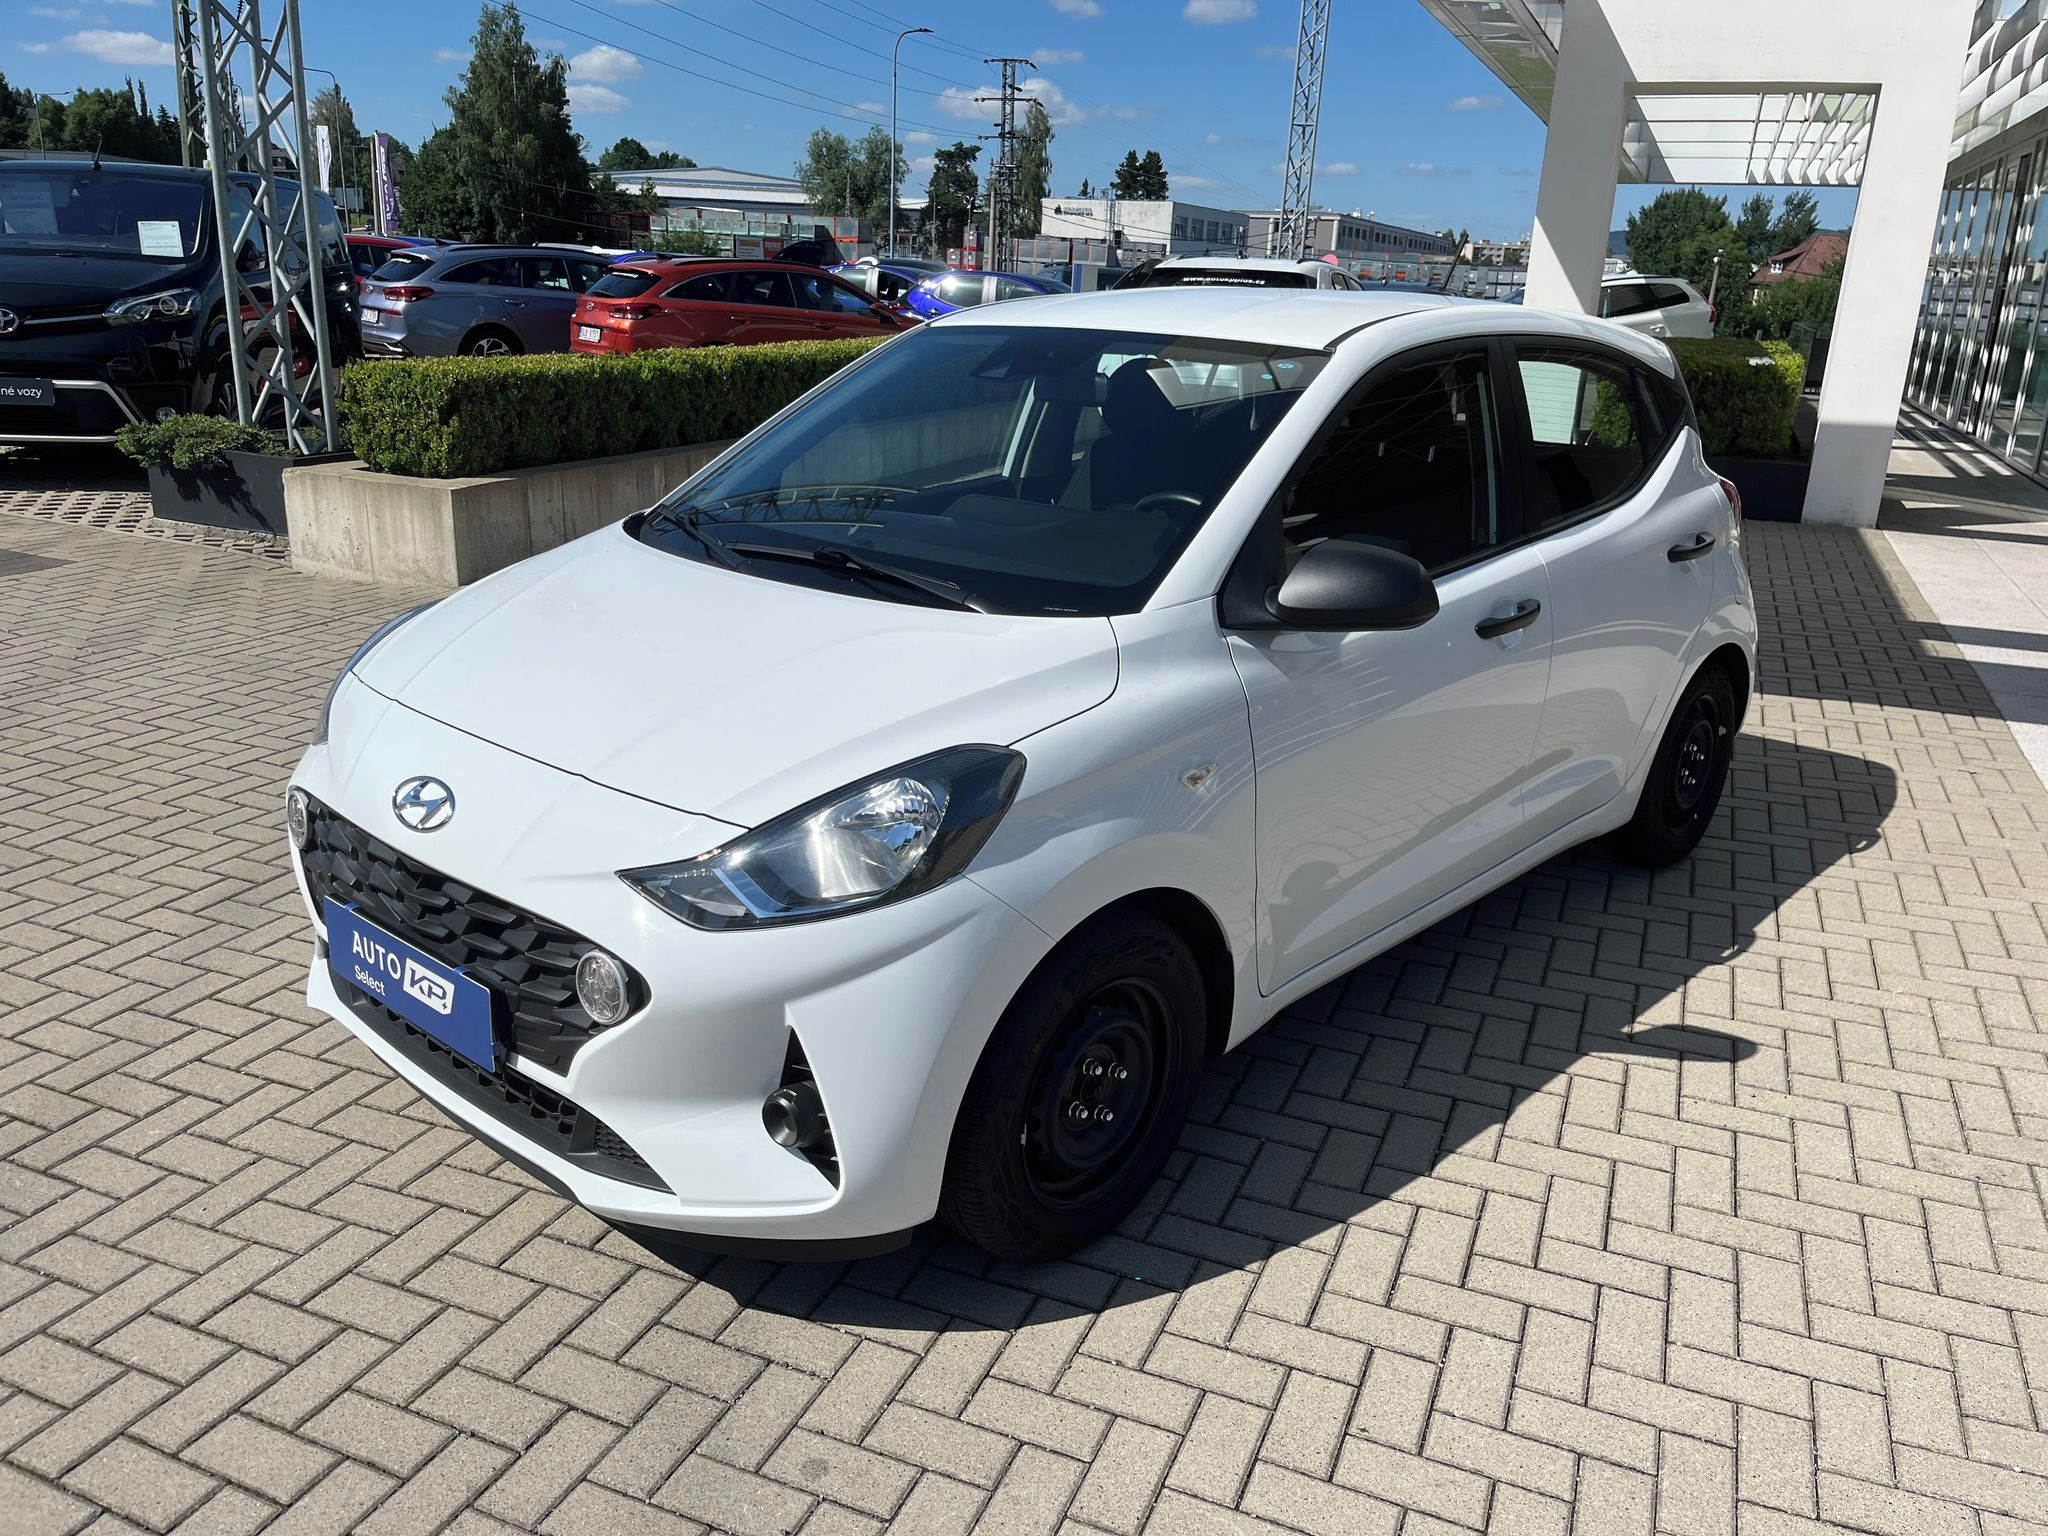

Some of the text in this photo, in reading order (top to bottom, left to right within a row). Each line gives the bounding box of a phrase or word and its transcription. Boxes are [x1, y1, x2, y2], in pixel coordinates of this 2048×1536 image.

[17, 388, 42, 399] vozy
[352, 930, 402, 980] AUTO
[354, 965, 386, 996] Select
